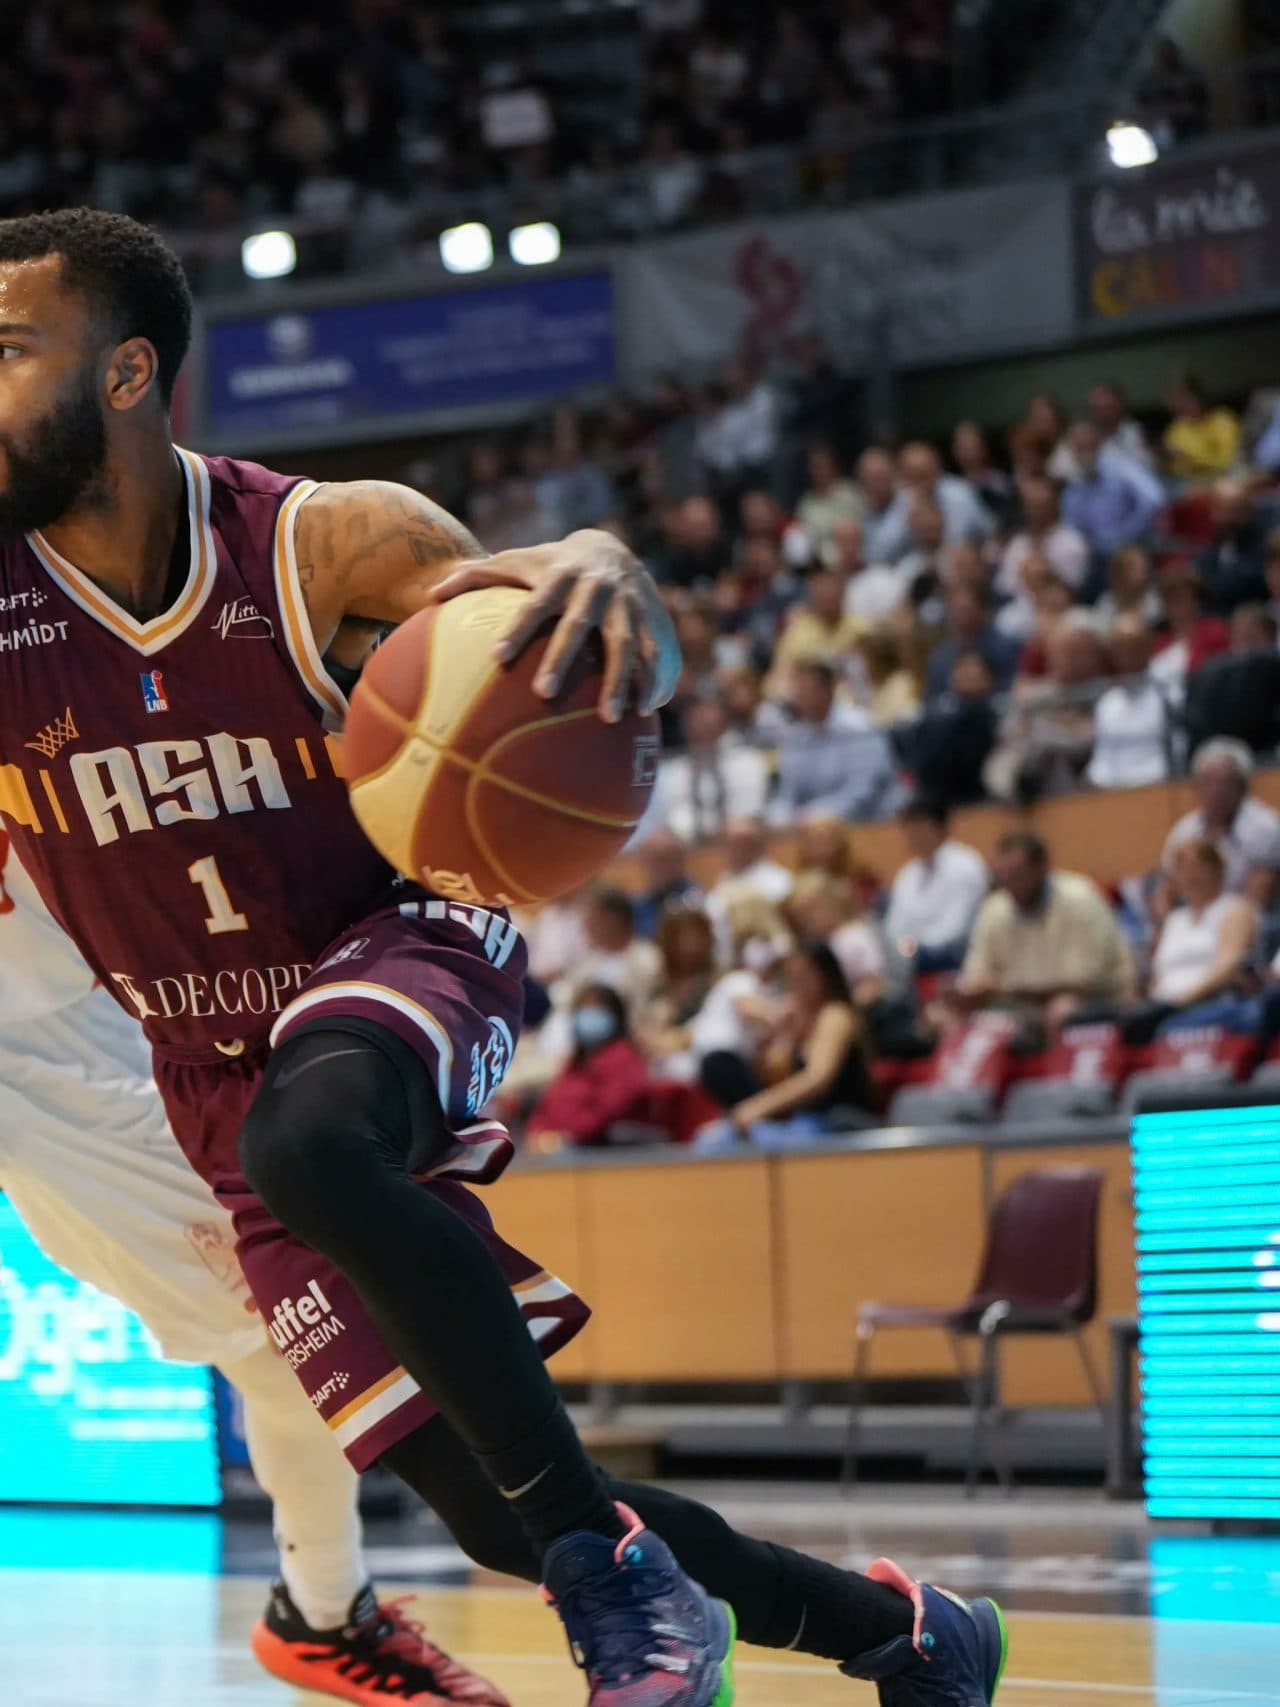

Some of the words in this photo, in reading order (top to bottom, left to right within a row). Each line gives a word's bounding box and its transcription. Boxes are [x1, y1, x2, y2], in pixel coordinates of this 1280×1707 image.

[147, 699, 169, 713] LNB
[70, 732, 292, 847] ASH
[188, 855, 249, 935] 1
